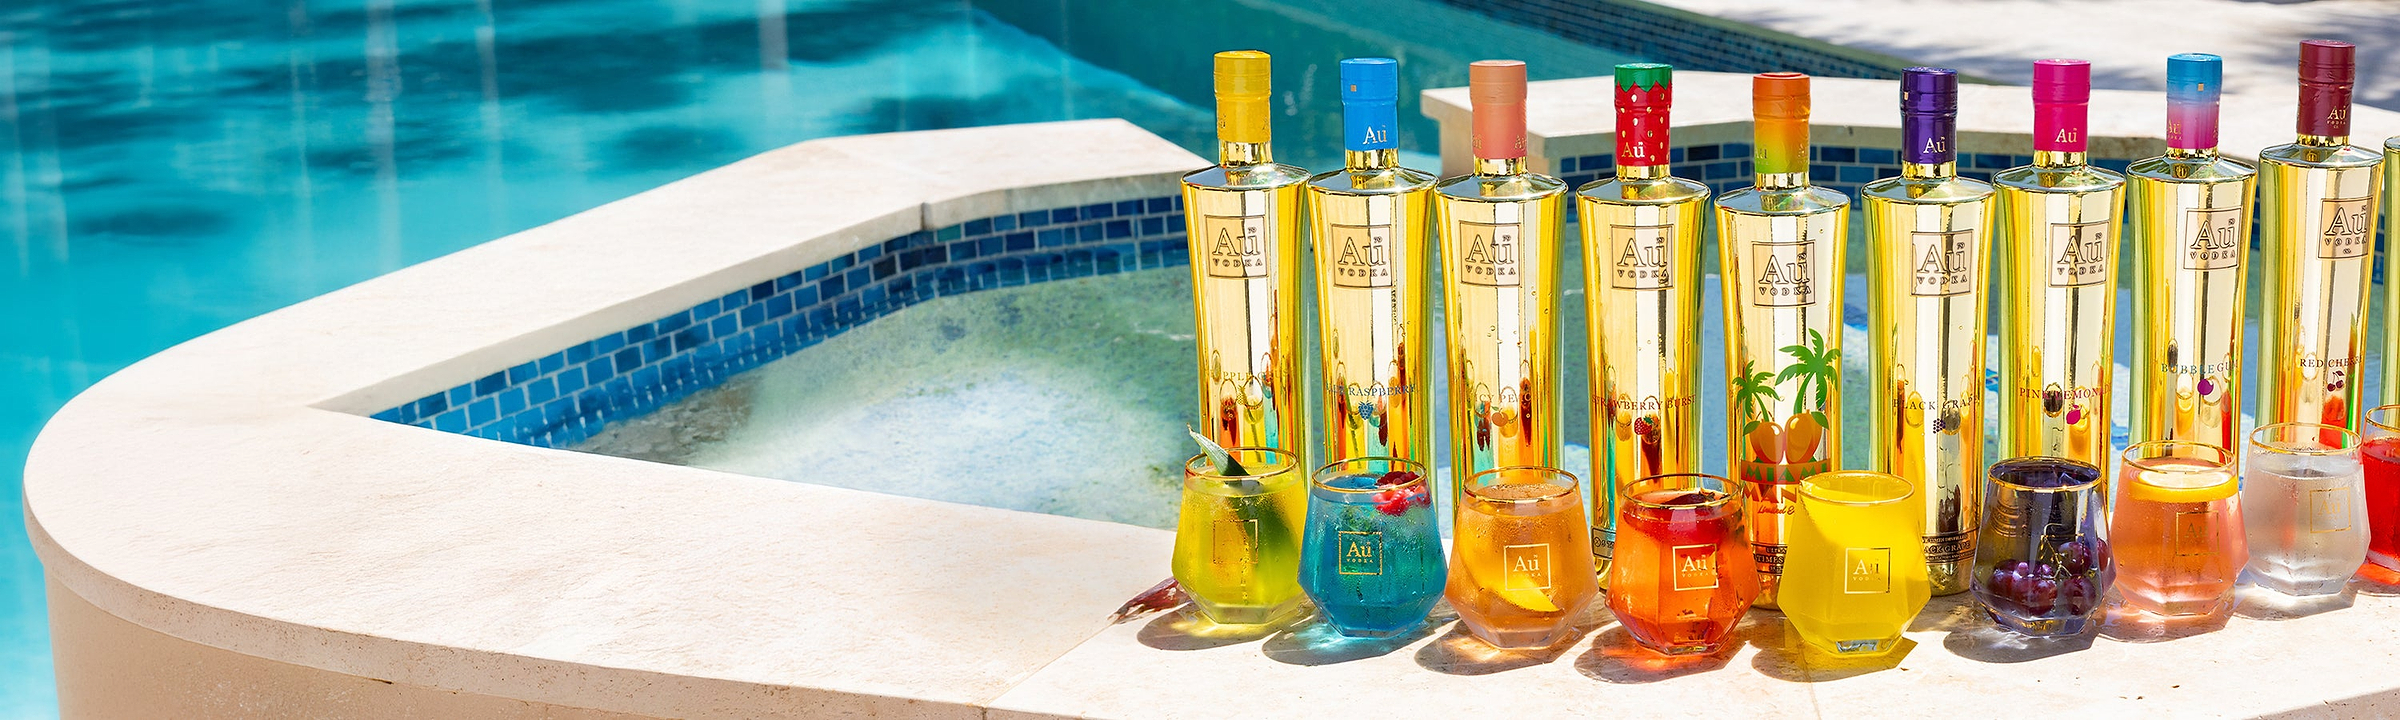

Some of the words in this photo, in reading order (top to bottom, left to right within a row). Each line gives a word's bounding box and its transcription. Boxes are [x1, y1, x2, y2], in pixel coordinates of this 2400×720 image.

[2324, 235, 2368, 246] VODKA
[2189, 249, 2236, 260] VODKA
[1212, 258, 1263, 268] VODKA
[1338, 267, 1388, 277] VODKA
[1465, 265, 1517, 275] VODKA
[1617, 269, 1669, 279] VODKA
[2056, 264, 2104, 276] VODKA
[1916, 274, 1968, 285] VODKA
[1758, 286, 1812, 296] VODKA
[2299, 358, 2324, 368] RED
[1348, 383, 1417, 397] RASPBERRY
[2019, 386, 2050, 400] PINK
[1666, 393, 1697, 409] BURST
[1745, 462, 1828, 482] MIAMI
[1741, 482, 1798, 504] MAN
[1346, 541, 1372, 558] Au
[1923, 544, 1944, 554] ACK
[1512, 555, 1540, 572] Au
[1681, 555, 1708, 572] Au
